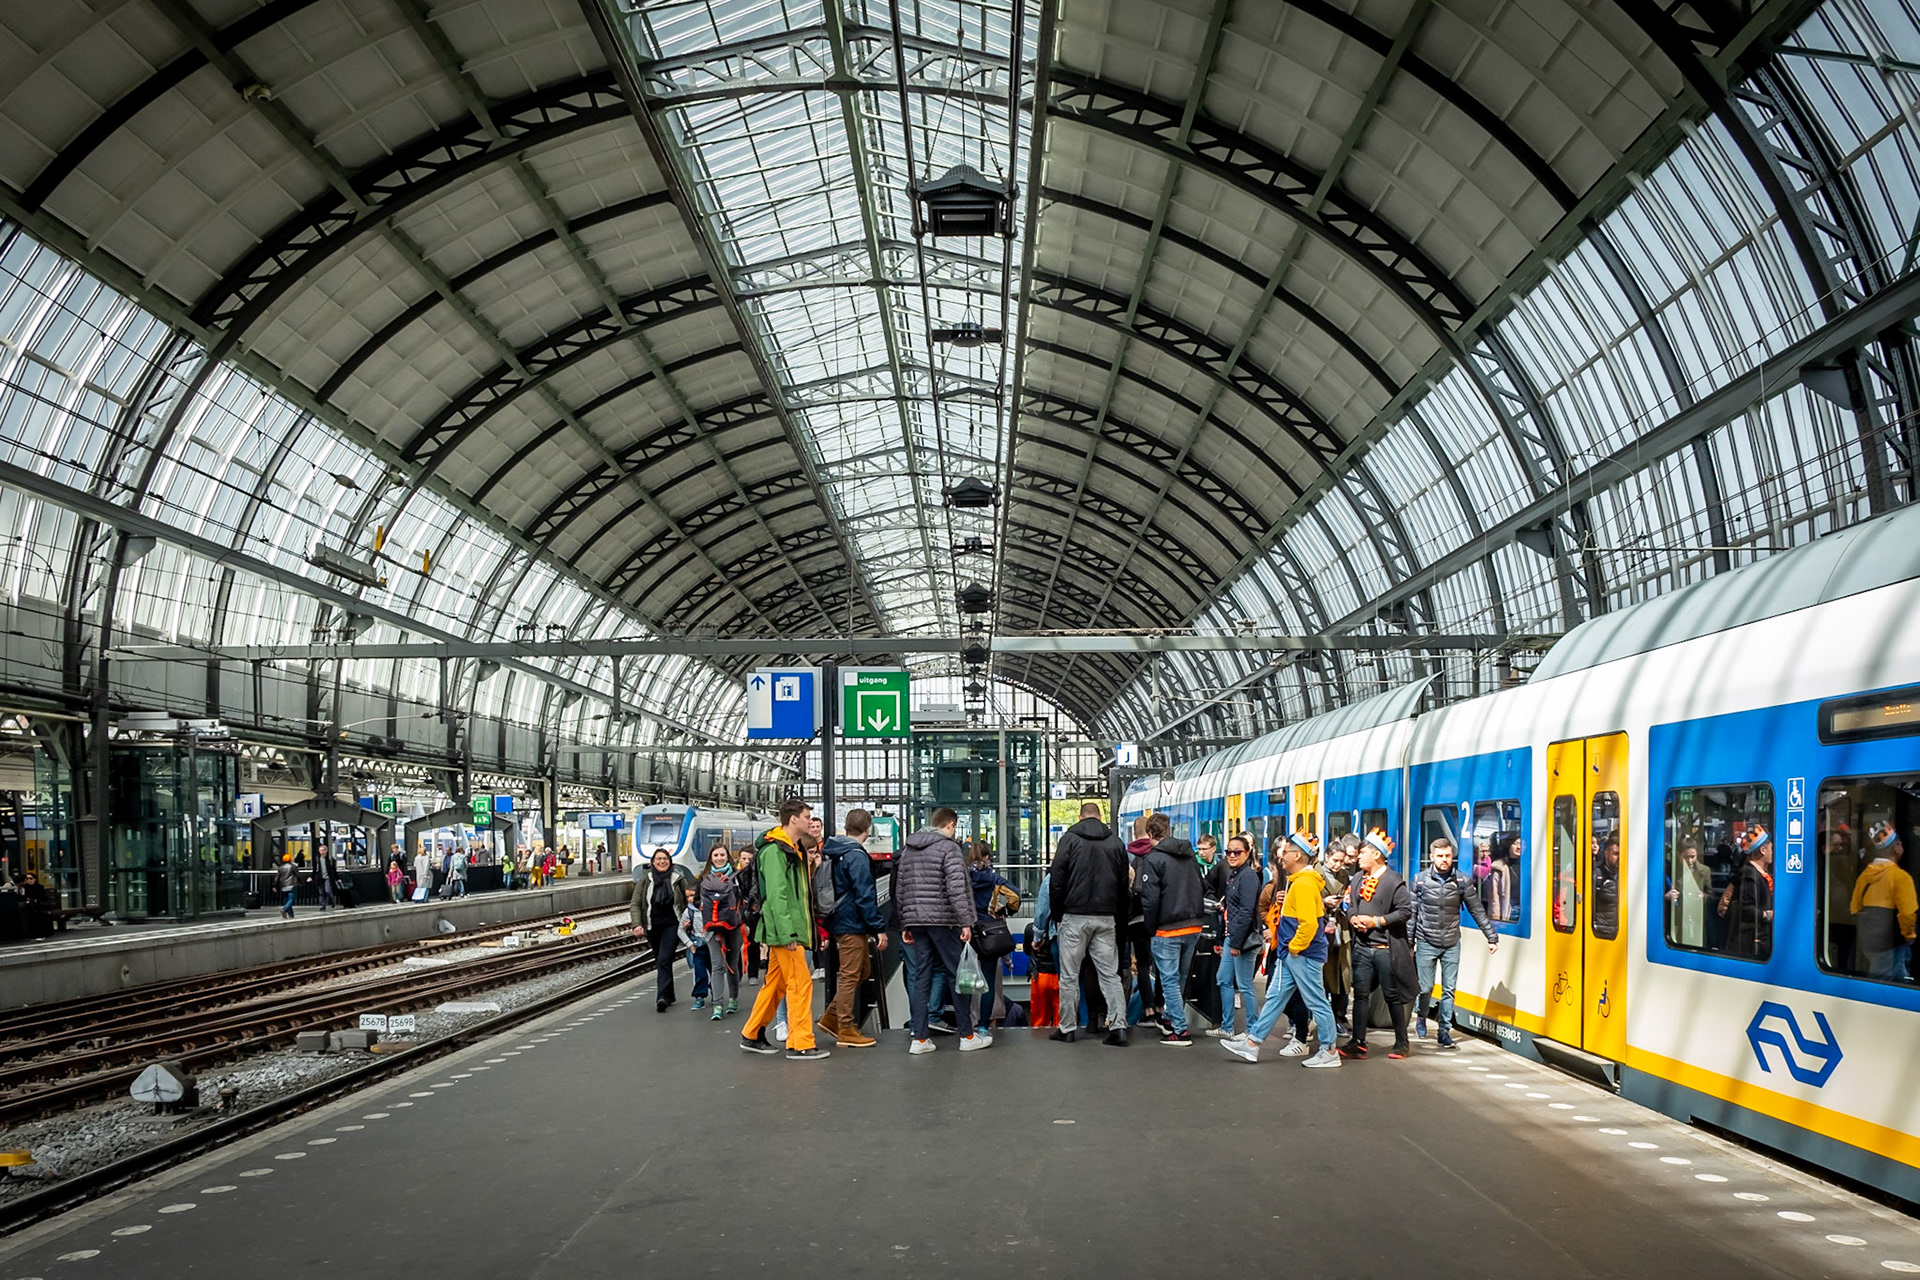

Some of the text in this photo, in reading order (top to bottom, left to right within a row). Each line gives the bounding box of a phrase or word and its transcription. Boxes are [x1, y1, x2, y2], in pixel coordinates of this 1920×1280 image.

[859, 677, 887, 685] uitgang
[1163, 782, 1174, 796] V
[1263, 815, 1268, 838] 2
[1352, 809, 1359, 837] 2
[1461, 801, 1471, 839] 2
